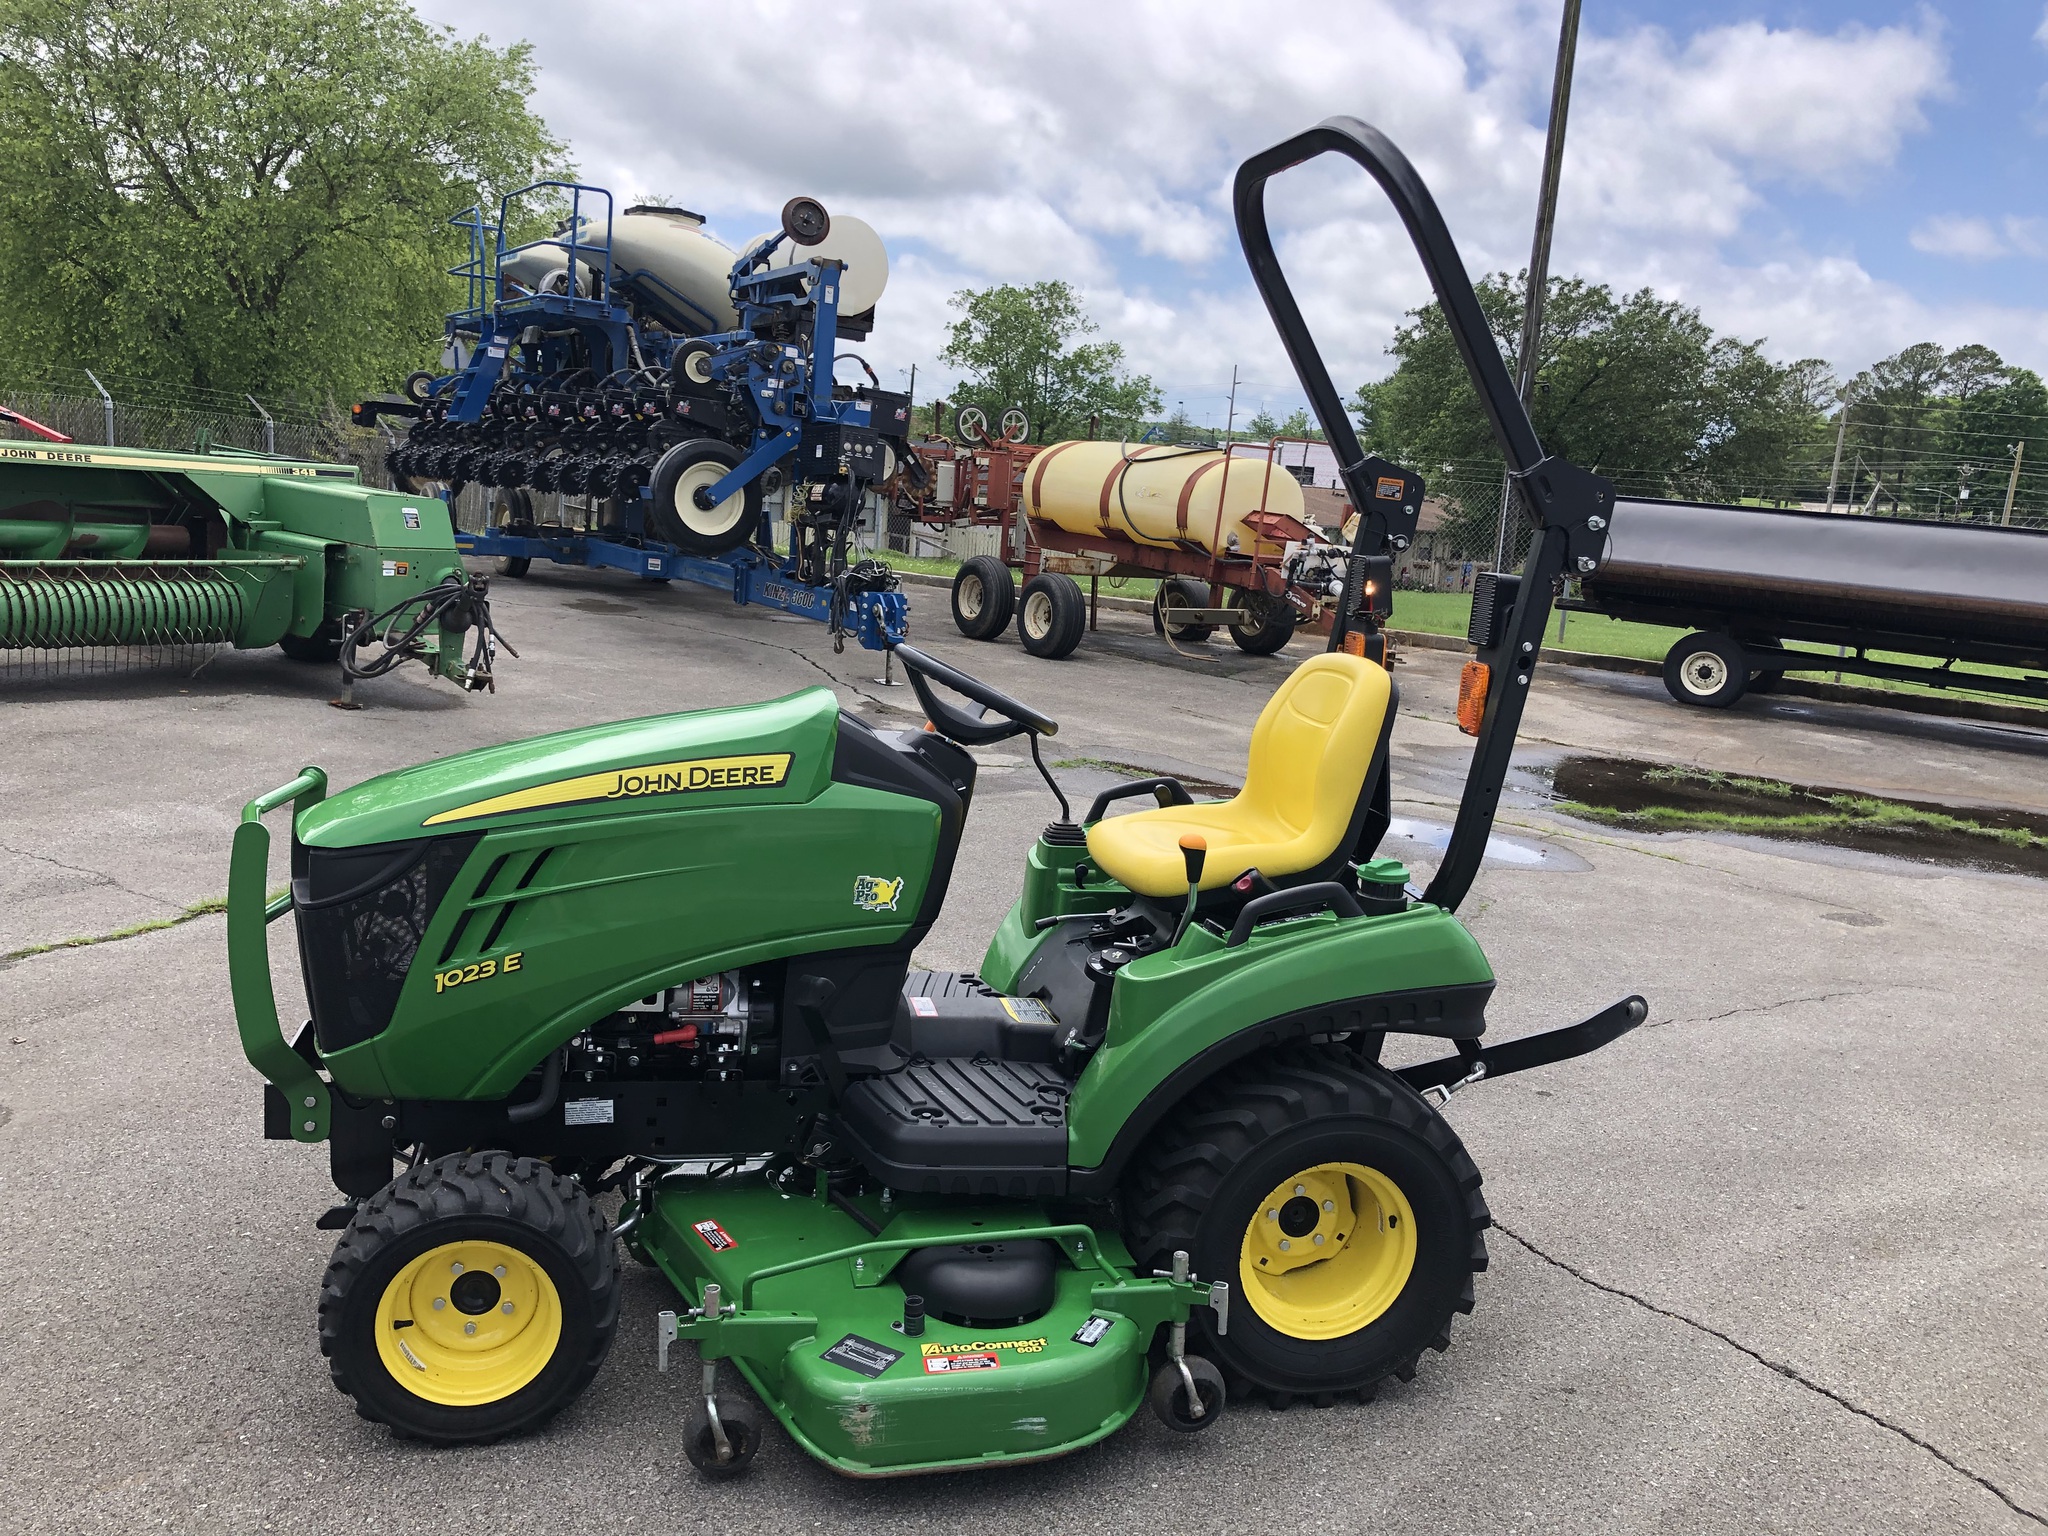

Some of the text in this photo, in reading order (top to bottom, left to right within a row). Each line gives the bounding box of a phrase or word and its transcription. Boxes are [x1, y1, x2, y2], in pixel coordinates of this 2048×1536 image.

[1, 449, 92, 463] JOHN DEERE
[292, 467, 317, 477] 348
[791, 589, 815, 609] 3600
[607, 765, 775, 797] JOHN DEERE
[855, 890, 878, 902] Pro
[434, 952, 524, 994] 1023 E
[920, 1337, 1048, 1356] AutoConnect
[1016, 1346, 1043, 1354] 60D
